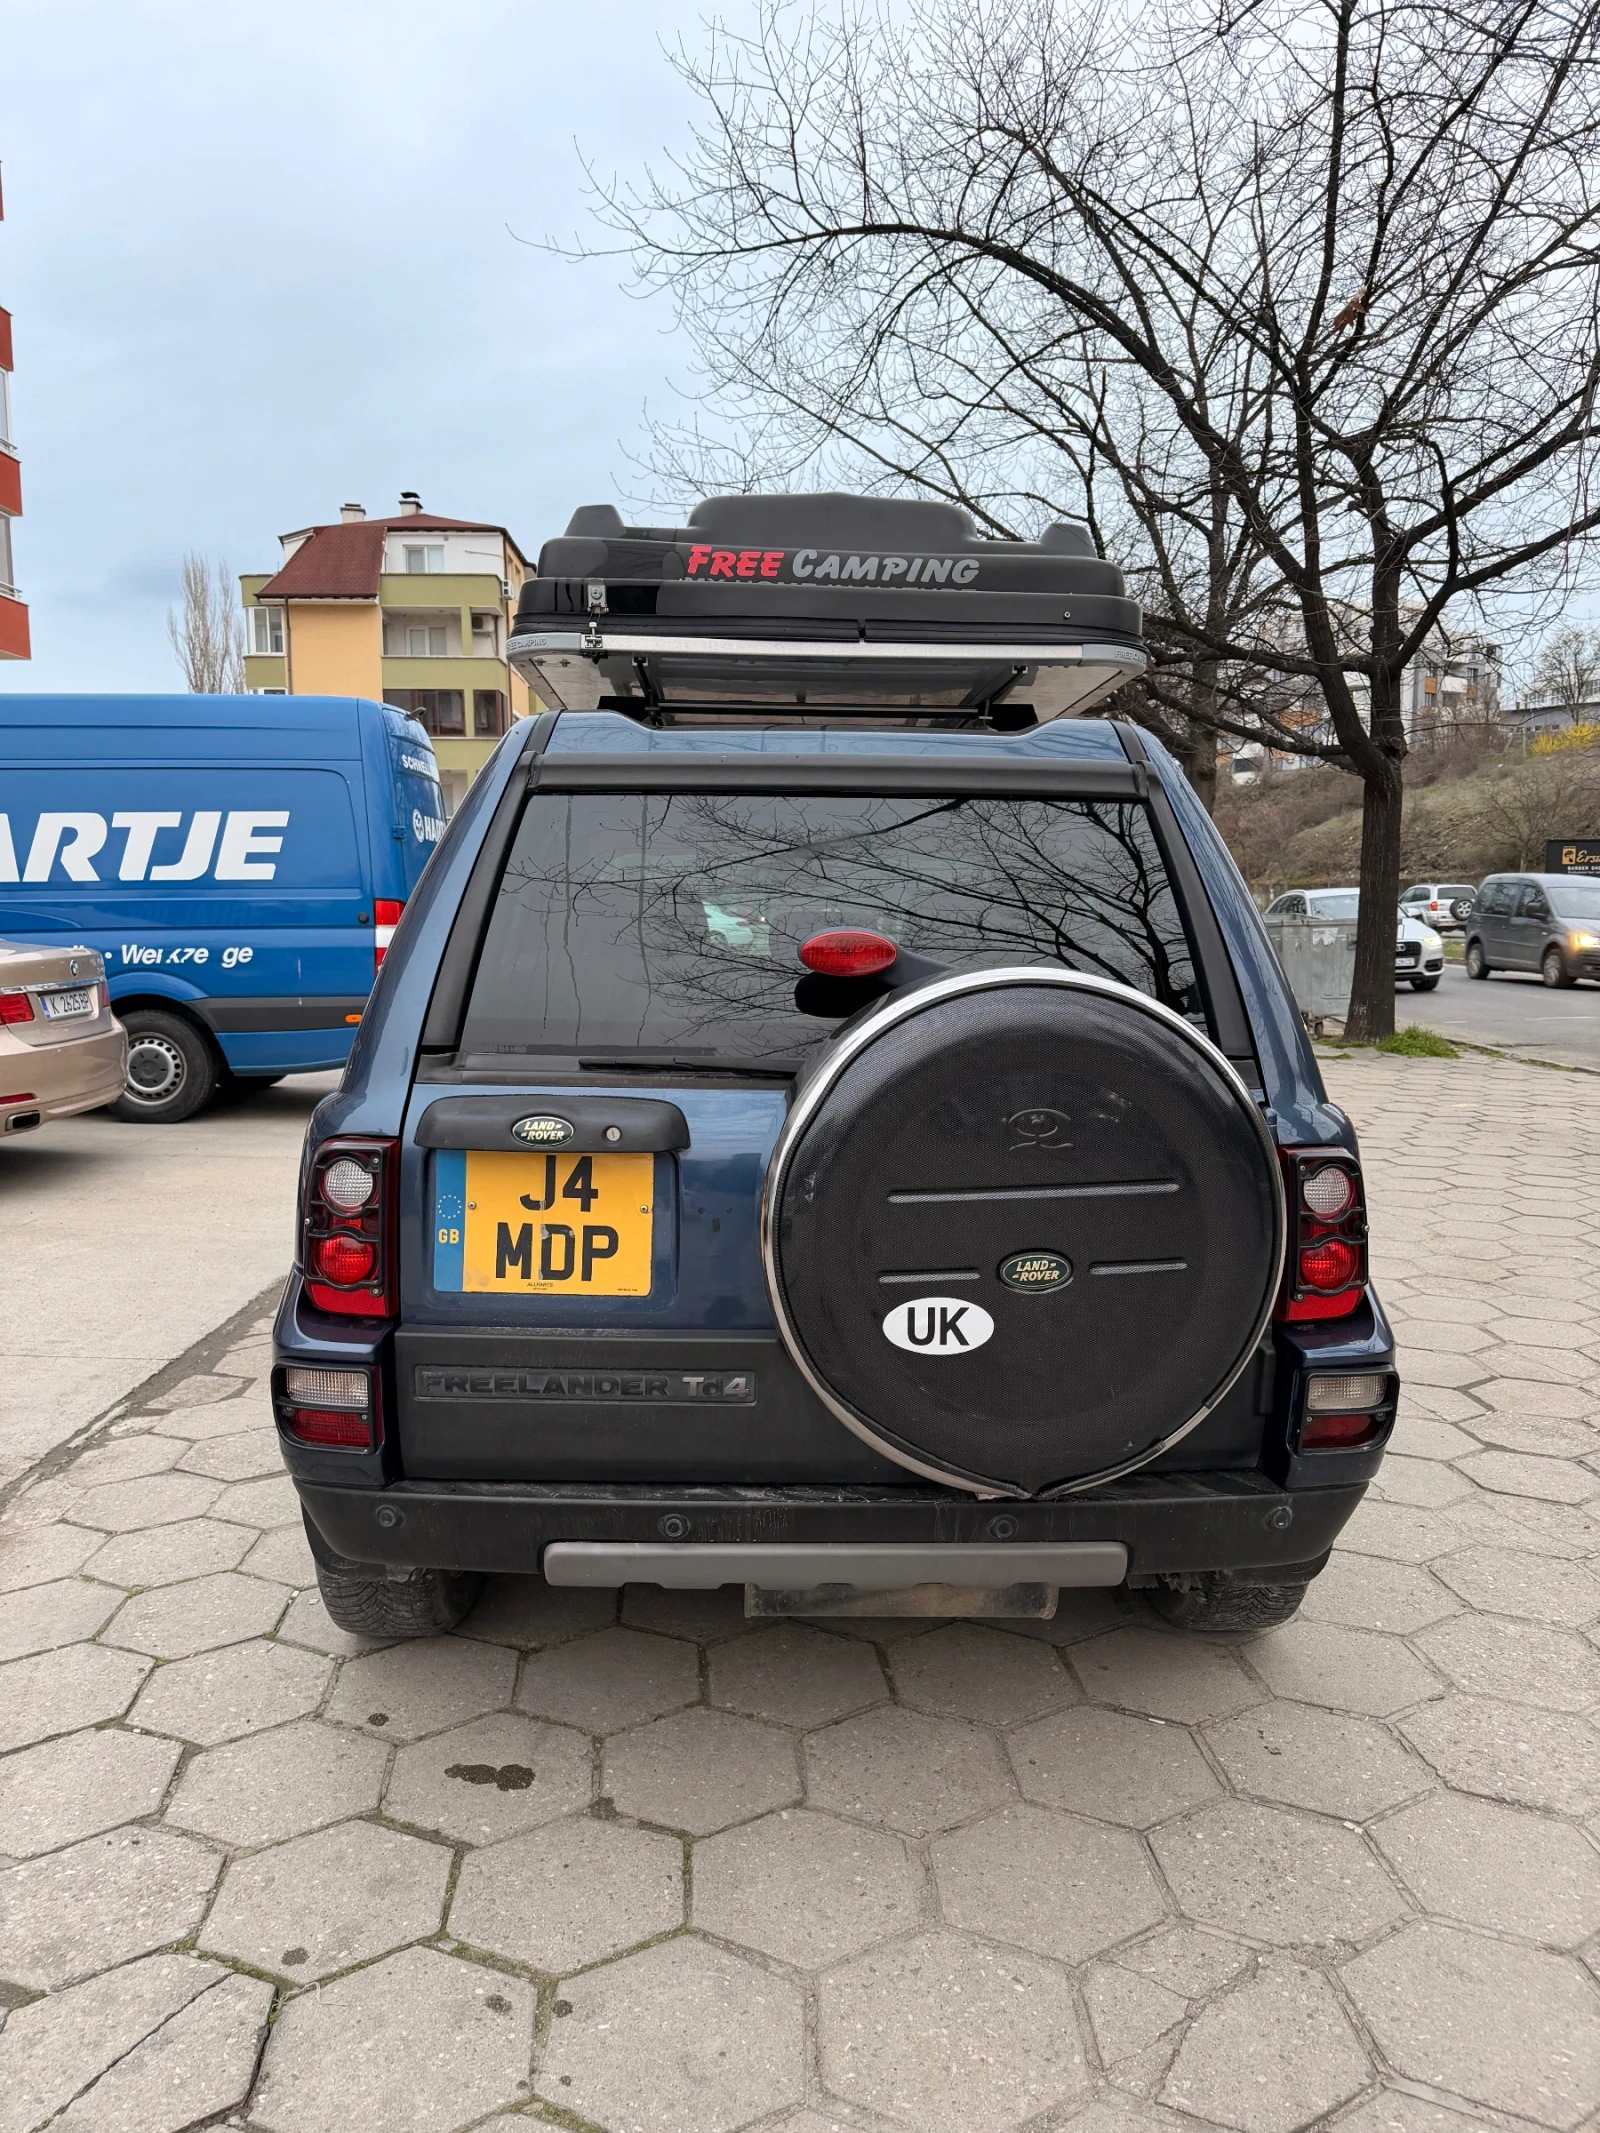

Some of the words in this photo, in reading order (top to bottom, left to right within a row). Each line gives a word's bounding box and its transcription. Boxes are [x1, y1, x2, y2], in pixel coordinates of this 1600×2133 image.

[687, 545, 784, 578] FREE
[792, 549, 980, 584] CAMPING
[0, 811, 290, 882] RTJE
[524, 1121, 556, 1131] LAND
[526, 1130, 565, 1140] ROVER
[519, 1154, 599, 1212] J4
[438, 1229, 460, 1244] GB
[495, 1222, 620, 1282] MDP
[1016, 1260, 1049, 1272] LAND
[1019, 1270, 1060, 1283] ROVER
[907, 1306, 970, 1346] UK
[422, 1371, 670, 1397] FREELANDER
[682, 1376, 749, 1398] Td4
